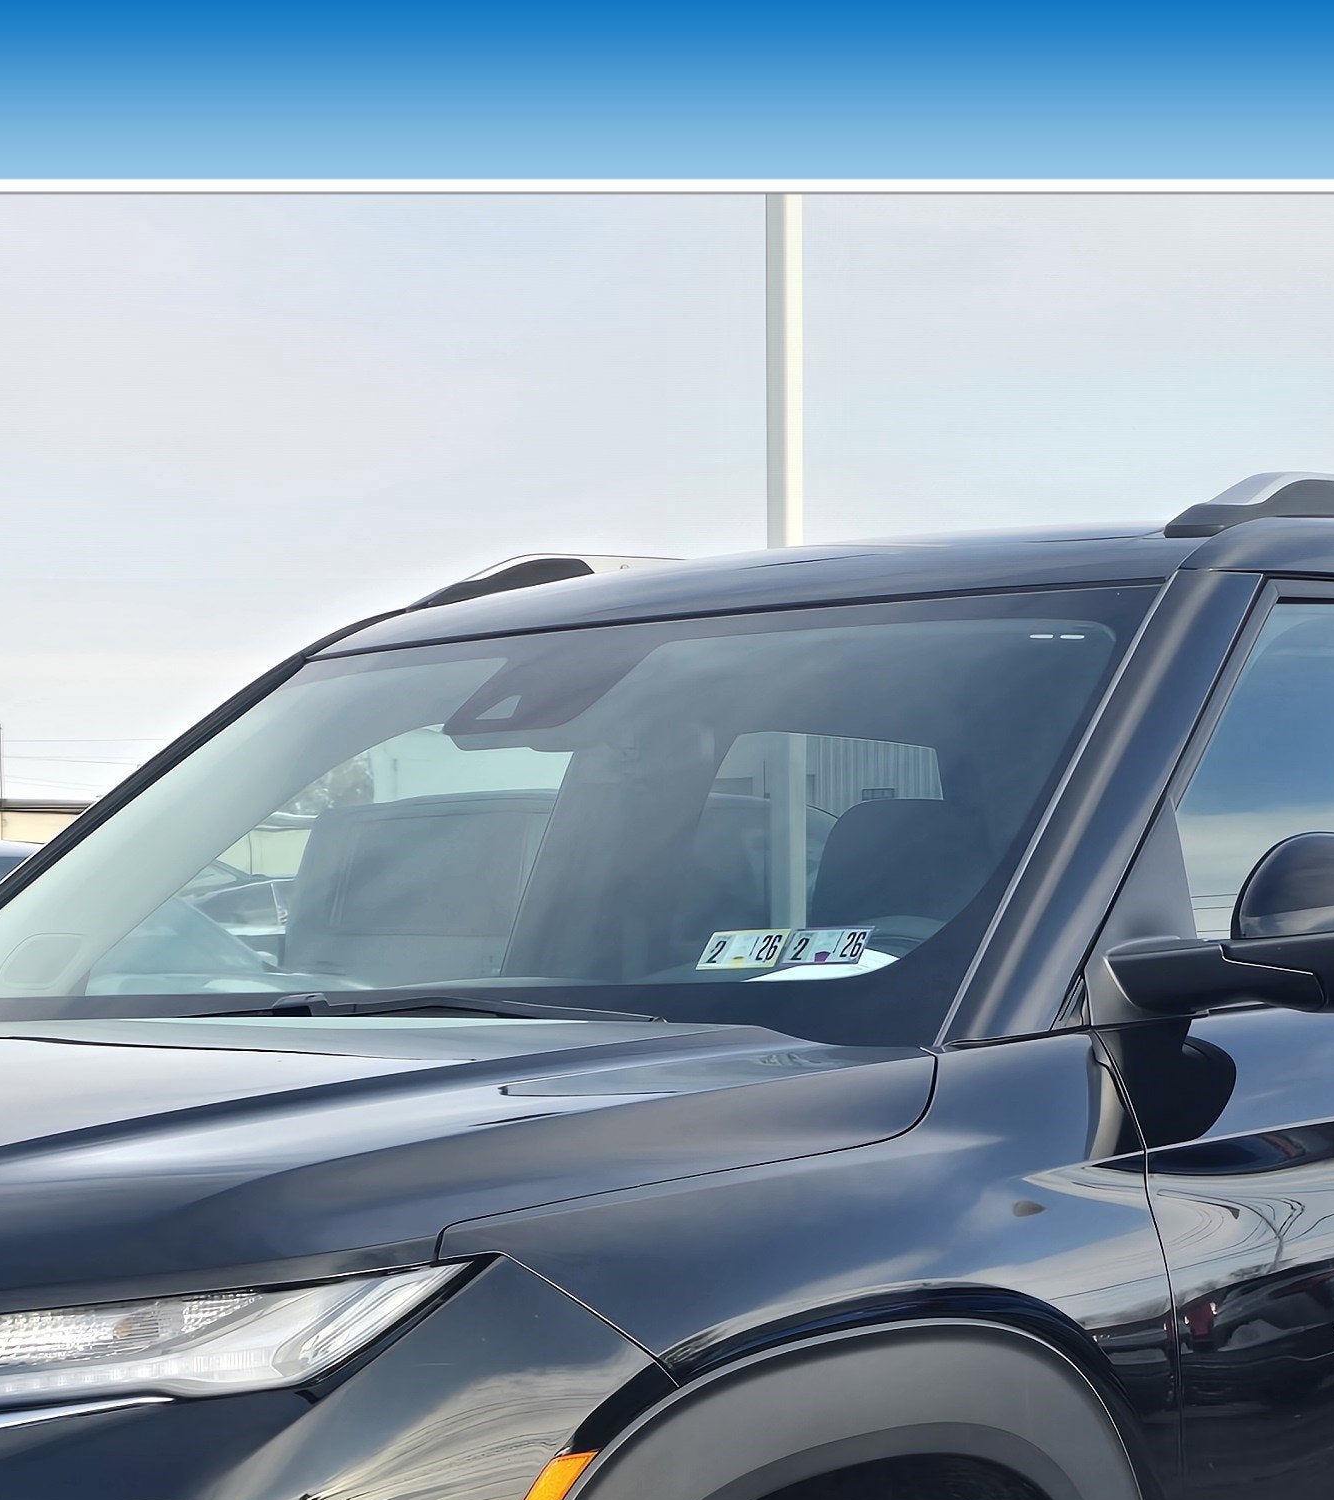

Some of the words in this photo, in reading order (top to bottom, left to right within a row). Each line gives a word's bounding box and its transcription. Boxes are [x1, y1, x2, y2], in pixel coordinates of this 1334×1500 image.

[706, 940, 727, 964] 2
[755, 934, 783, 962] 26
[790, 937, 810, 961] 2
[839, 931, 867, 958] 26
